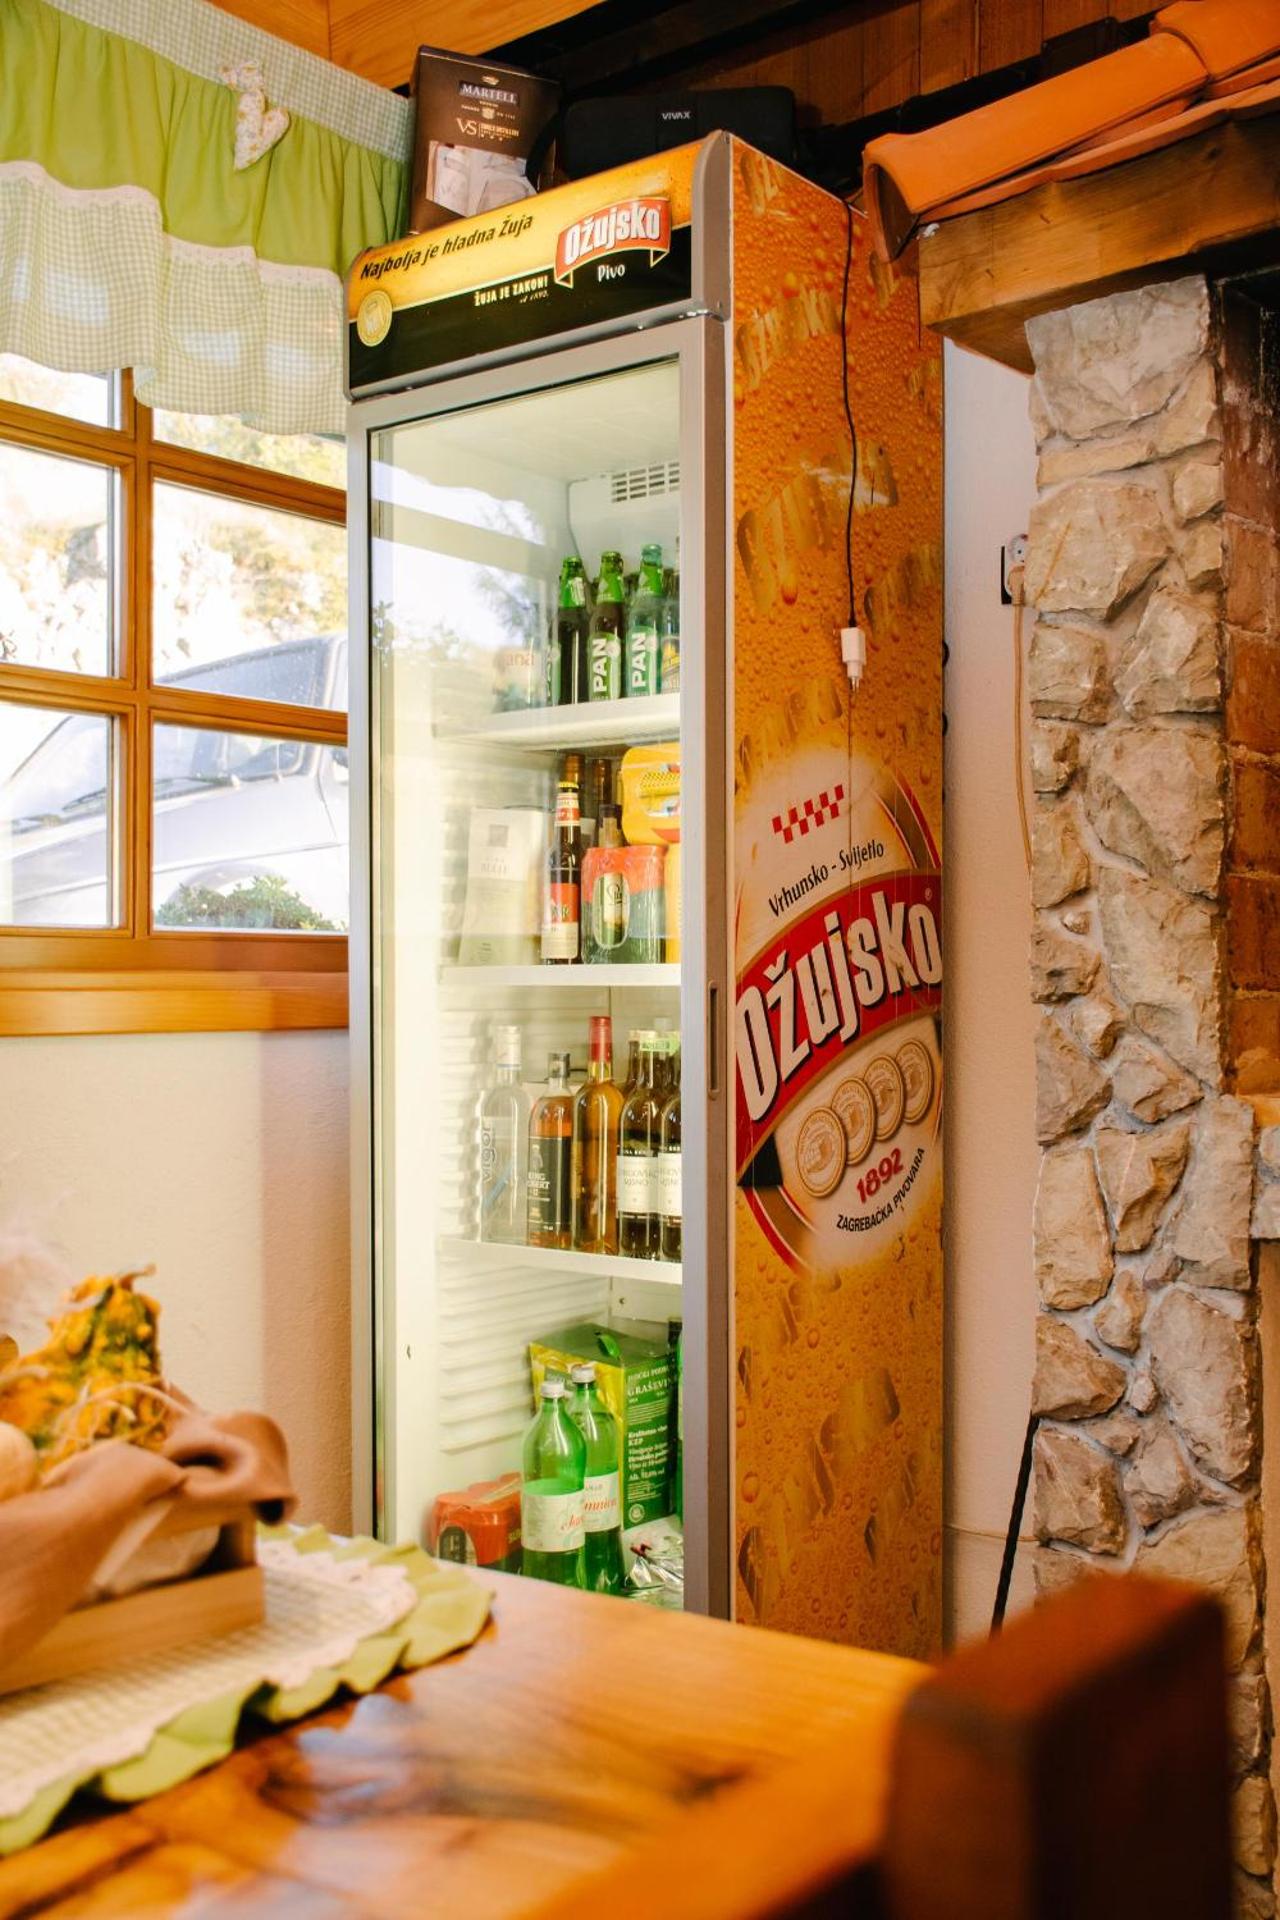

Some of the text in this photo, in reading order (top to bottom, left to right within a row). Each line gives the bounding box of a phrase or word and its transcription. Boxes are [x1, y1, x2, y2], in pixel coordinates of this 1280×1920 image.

[460, 84, 517, 105] MARTELL
[661, 110, 691, 120] VIVAX
[456, 117, 477, 136] VS
[360, 214, 534, 280] Najbolja je hladna Žuja
[564, 202, 660, 266] Ožujsko
[474, 290, 498, 307] ŽUJA
[499, 285, 511, 301] JE
[512, 274, 549, 297] ZAKON!
[597, 264, 626, 283] Pivo
[593, 637, 608, 693] PAN
[631, 631, 647, 688] PAN
[768, 864, 829, 918] Vrhunsko
[839, 839, 884, 872] Svijetlo
[736, 890, 943, 1122] Ožujsko
[836, 1147, 925, 1232] ZAGREBAČKA PIVOVARA
[857, 1147, 904, 1204] 1892
